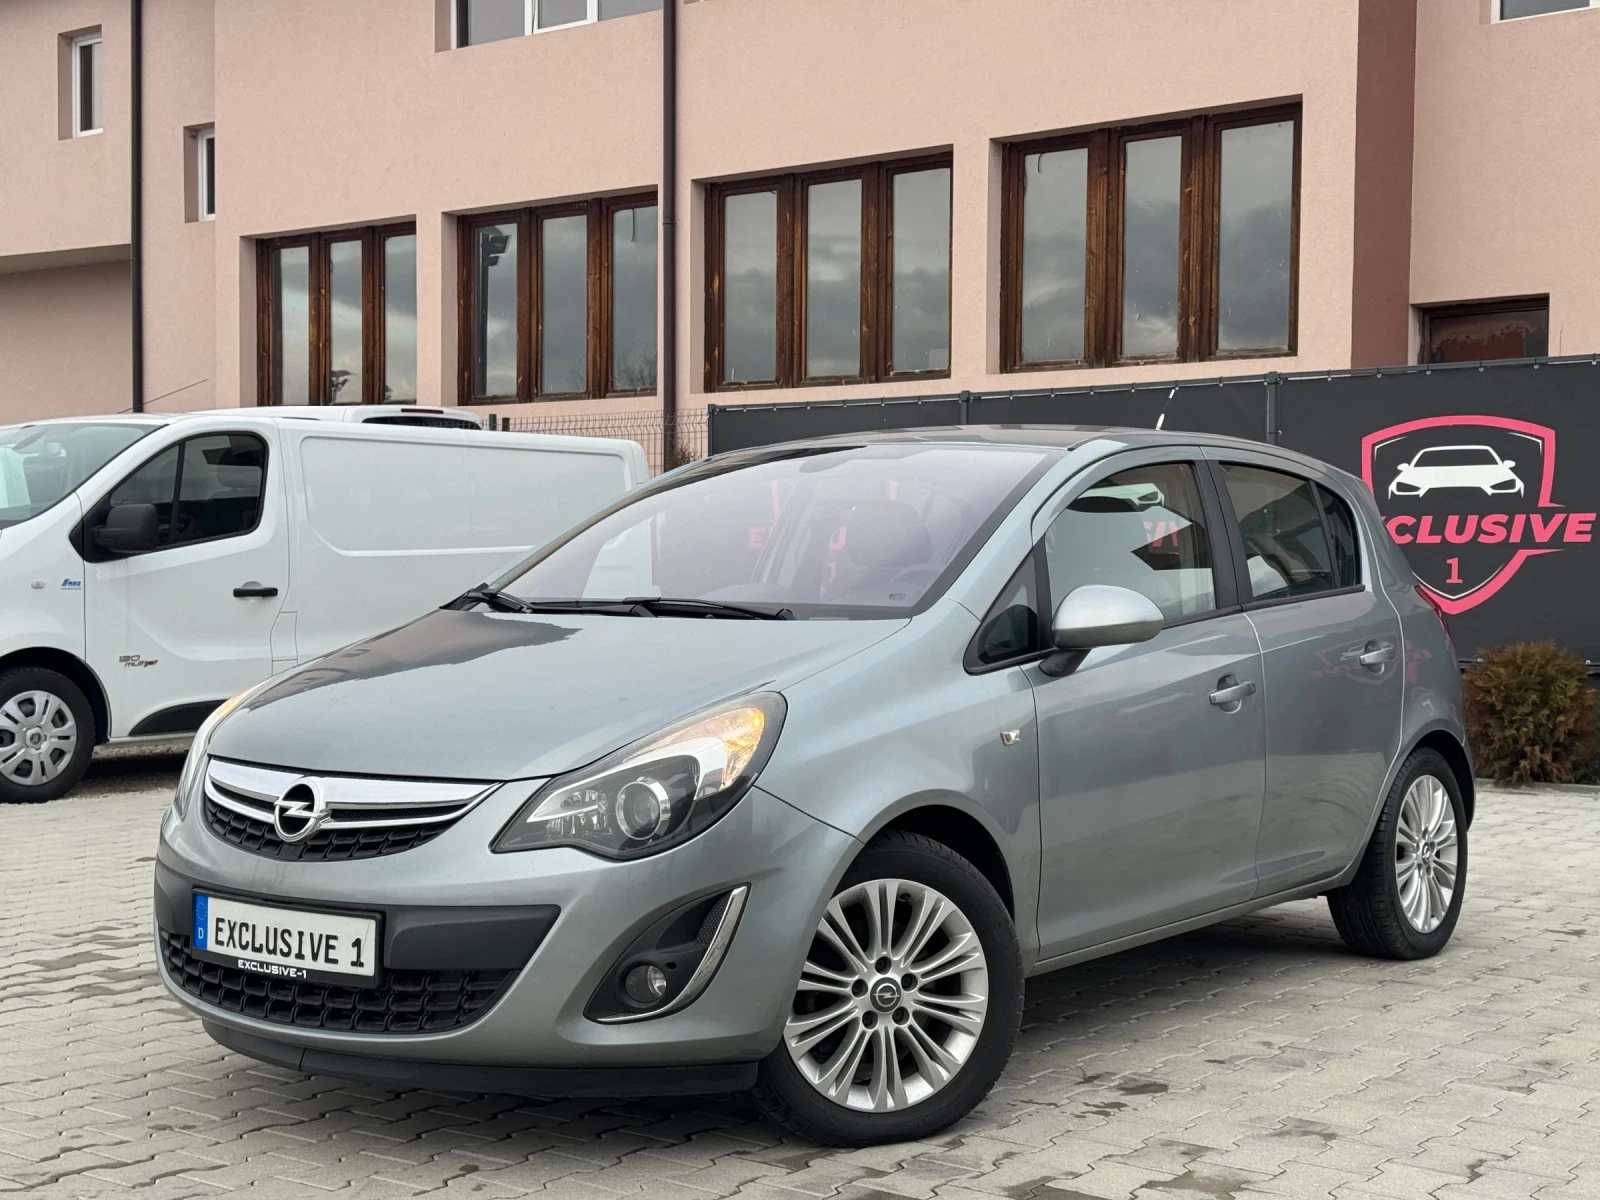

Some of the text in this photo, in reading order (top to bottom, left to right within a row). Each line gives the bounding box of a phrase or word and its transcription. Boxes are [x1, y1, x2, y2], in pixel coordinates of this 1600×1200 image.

[1380, 512, 1597, 545] CLUSIVE
[1445, 557, 1463, 584] 1
[198, 927, 204, 940] D
[215, 916, 365, 968] EXCLUSIVE 1
[237, 959, 307, 979] EXCLUSIVE-1
